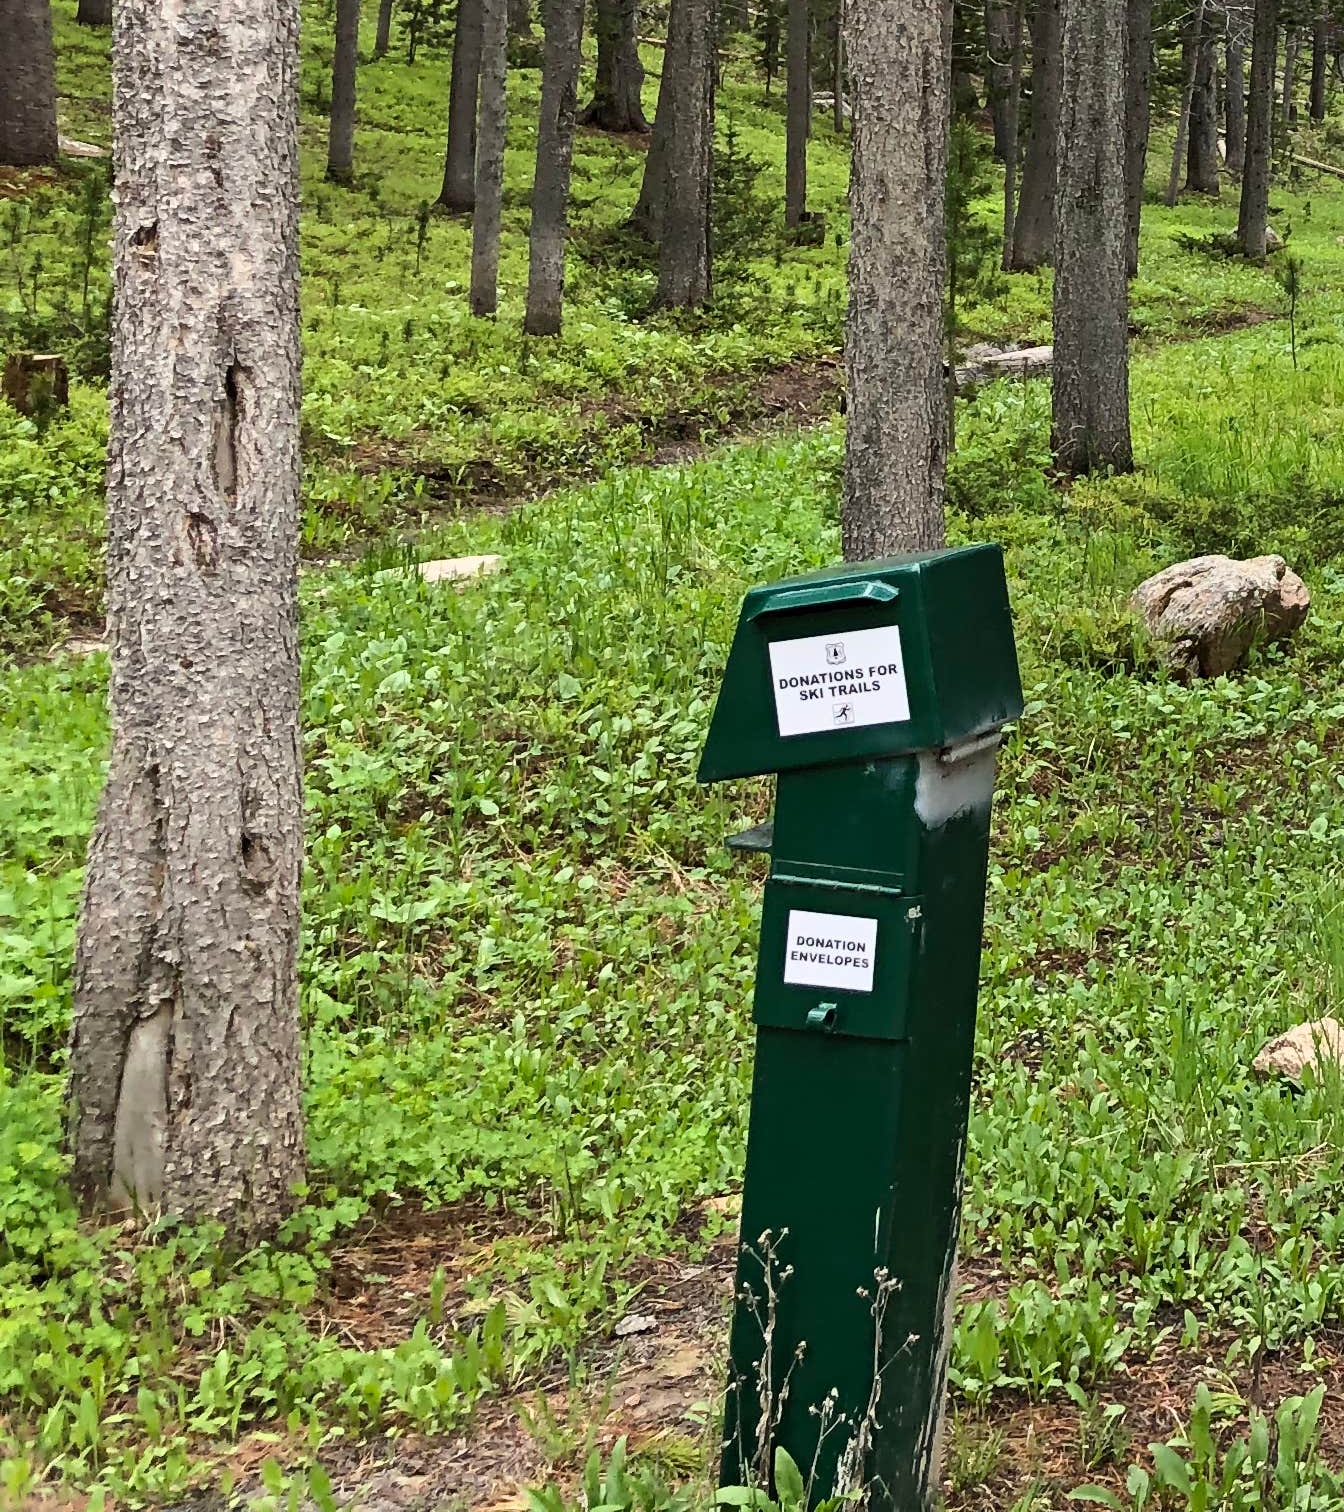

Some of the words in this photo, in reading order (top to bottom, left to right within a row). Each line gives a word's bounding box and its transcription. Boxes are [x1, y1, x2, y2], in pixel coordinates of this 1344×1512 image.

[779, 668, 864, 690] DONATIONS
[868, 663, 898, 678] FOR
[799, 687, 824, 701] SKI
[828, 680, 881, 697] TRAILS
[796, 935, 866, 953] DONATION
[790, 950, 869, 969] ENVELOPES
